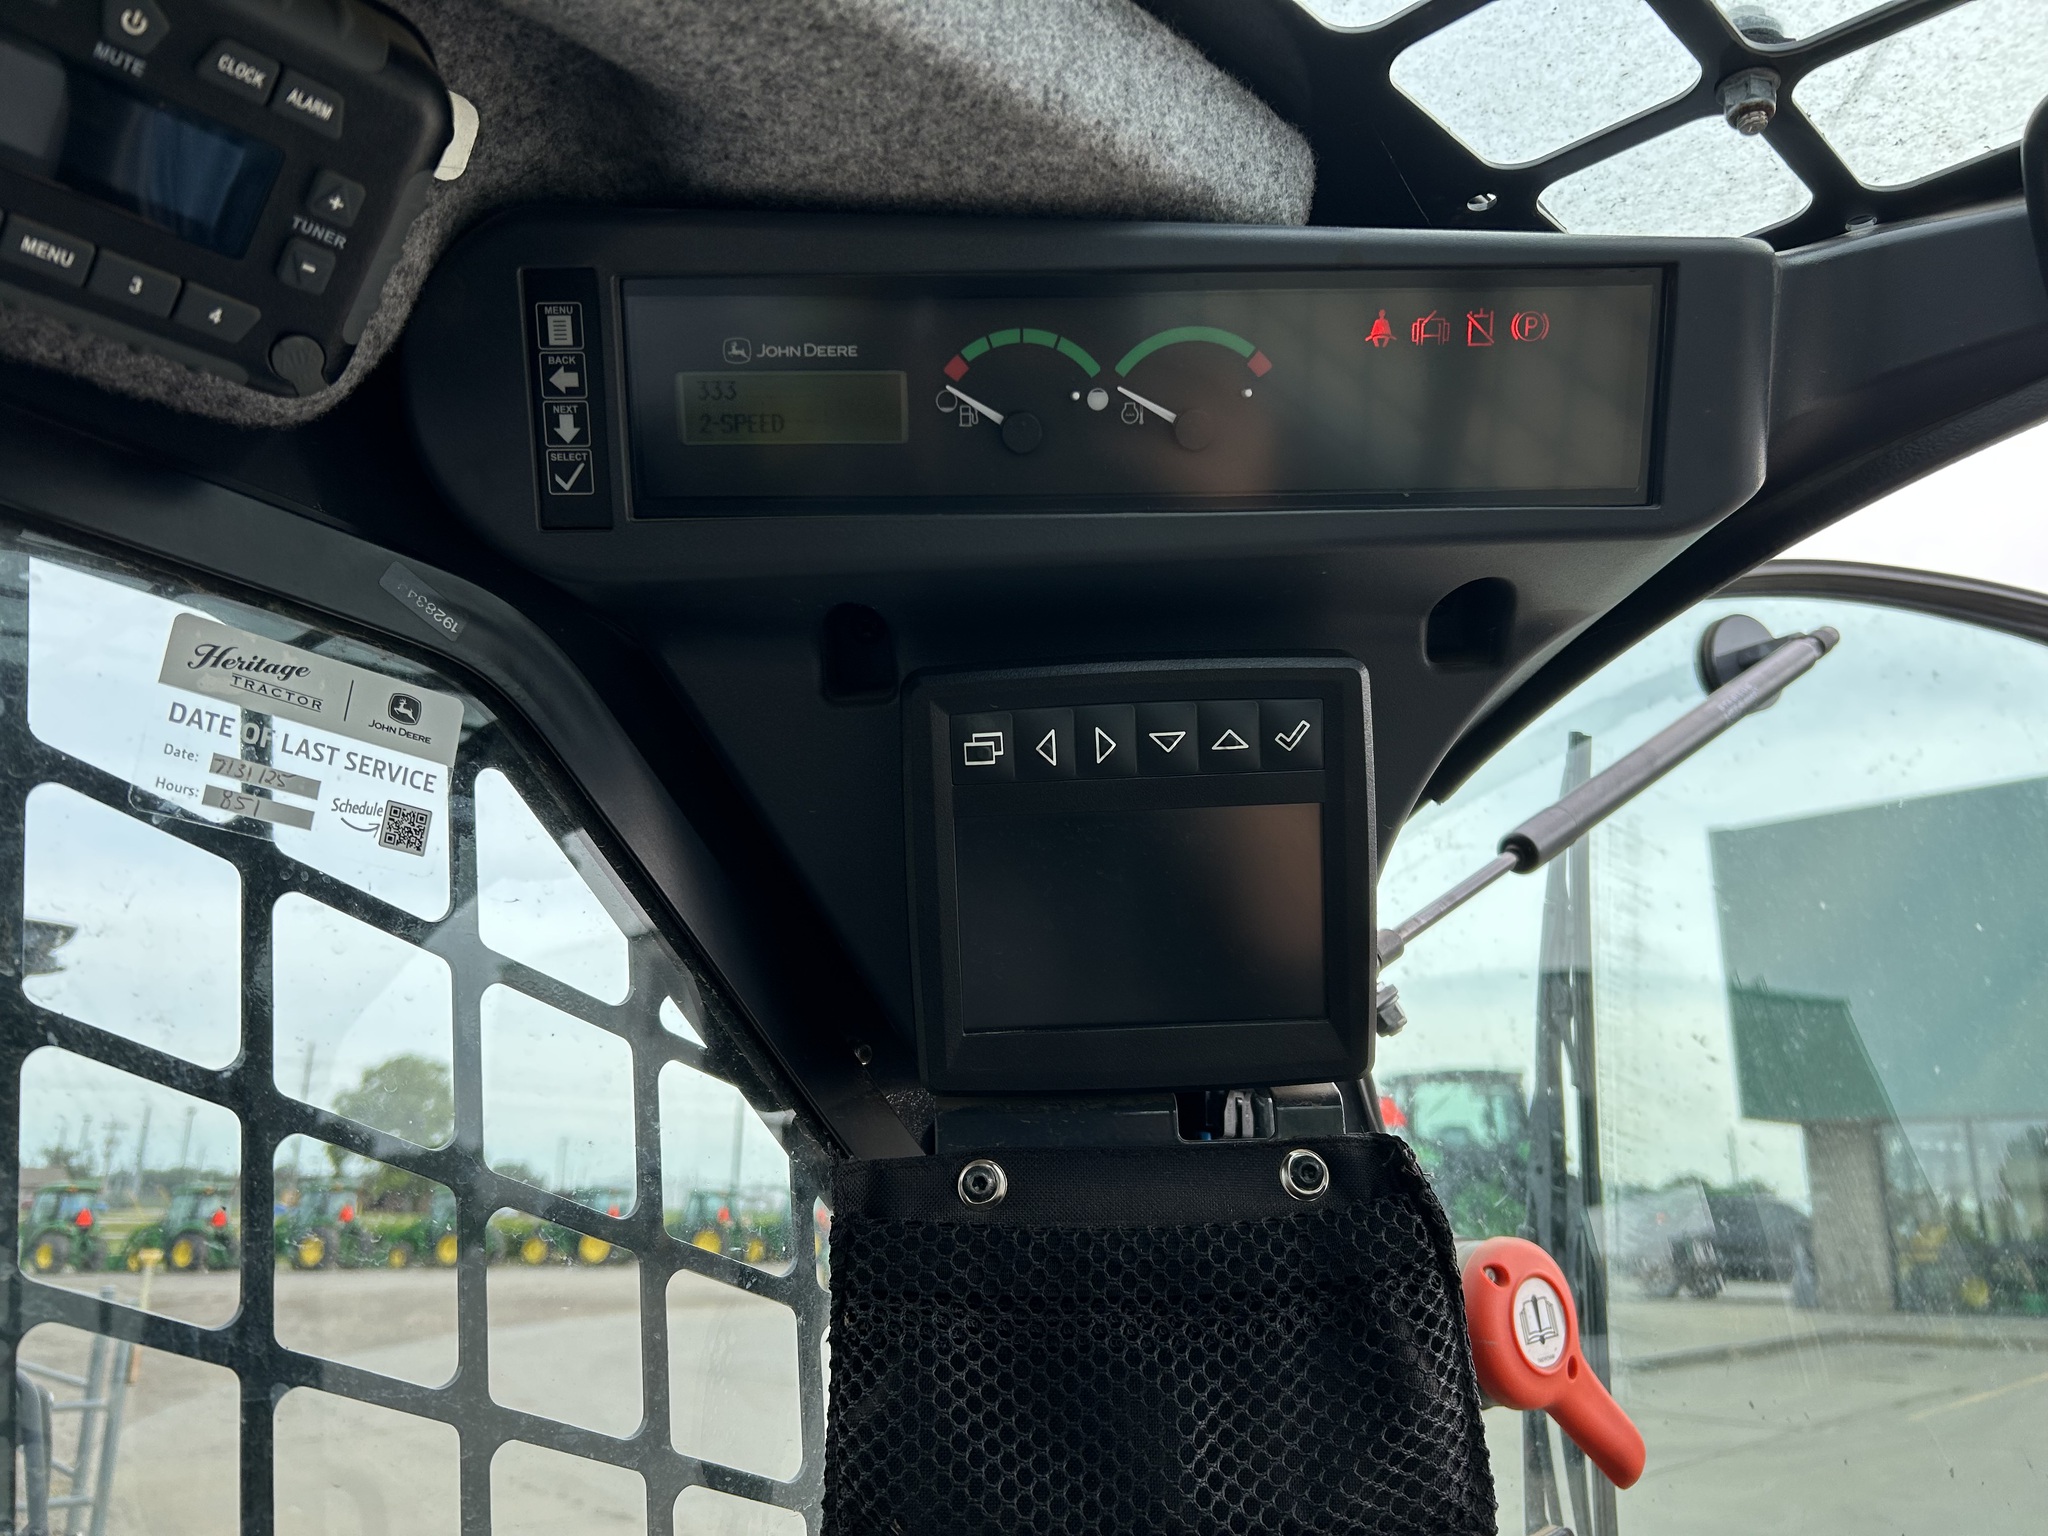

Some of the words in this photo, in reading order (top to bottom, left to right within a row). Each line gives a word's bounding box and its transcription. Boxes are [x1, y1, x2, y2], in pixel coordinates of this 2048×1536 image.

[93, 42, 147, 78] MUTE
[217, 54, 267, 89] CLOCK
[286, 88, 333, 121] ALARM
[292, 216, 347, 250] TUNER
[20, 235, 75, 268] MENU
[128, 276, 143, 295] 3
[208, 306, 223, 325] 4
[544, 306, 573, 315] MENU
[548, 355, 576, 365] BACK
[756, 344, 801, 359] JOHN
[803, 343, 858, 358] DEERE
[697, 380, 737, 401] 333
[552, 405, 578, 414] NEXT
[699, 413, 785, 434] 2-SPEED
[550, 452, 588, 462] SELECT
[398, 583, 459, 633] 192834
[187, 643, 311, 681] Heritage
[231, 674, 324, 711] TRACTOR
[368, 719, 398, 737] JOHN
[398, 727, 432, 745] DEERE
[163, 743, 200, 763] Date:
[168, 702, 236, 739] DATE
[242, 722, 277, 749] OF
[281, 733, 341, 767] LAST
[344, 751, 438, 794] SERVICE
[155, 777, 200, 798] Hours:
[220, 790, 260, 817] 851
[331, 797, 384, 817] Schedule
